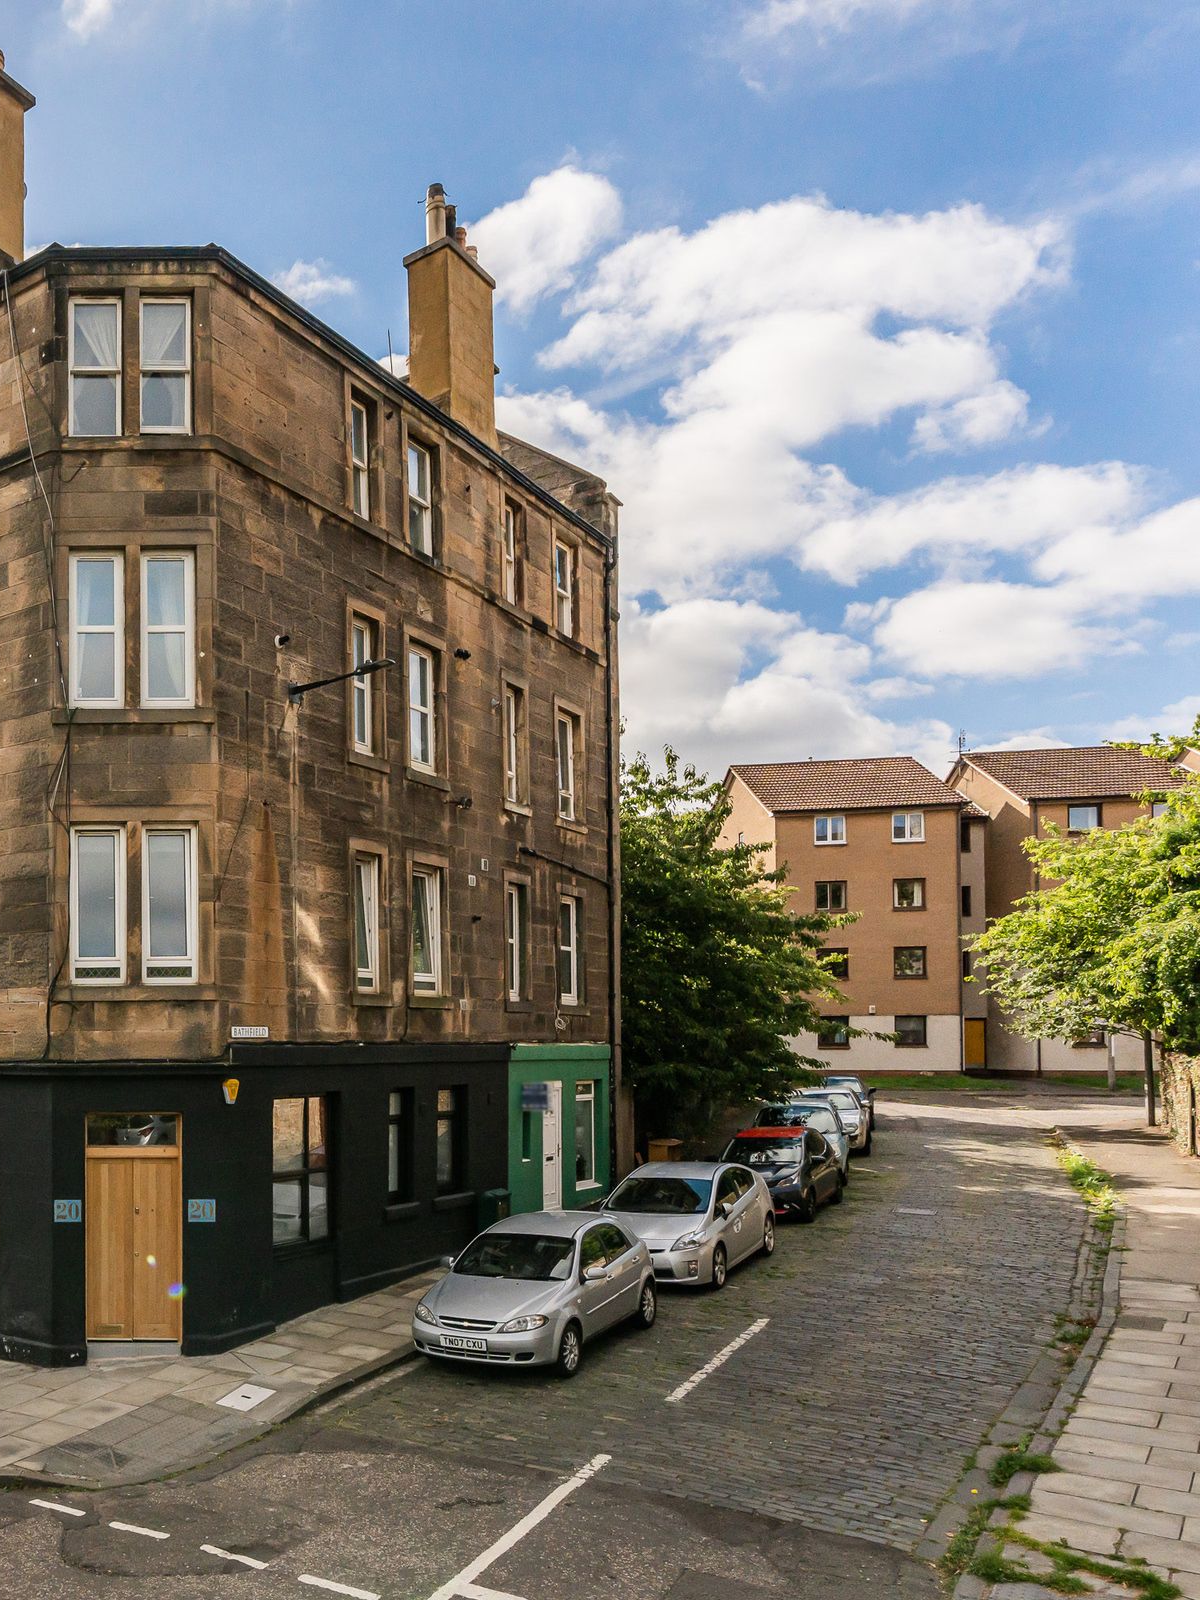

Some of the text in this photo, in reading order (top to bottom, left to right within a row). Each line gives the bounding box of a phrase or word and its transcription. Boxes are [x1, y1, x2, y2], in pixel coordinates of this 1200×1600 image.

[233, 1027, 267, 1037] BATHFIELD
[56, 1202, 80, 1220] 20
[191, 1201, 214, 1219] 20
[443, 1337, 483, 1349] TN07 CXU
